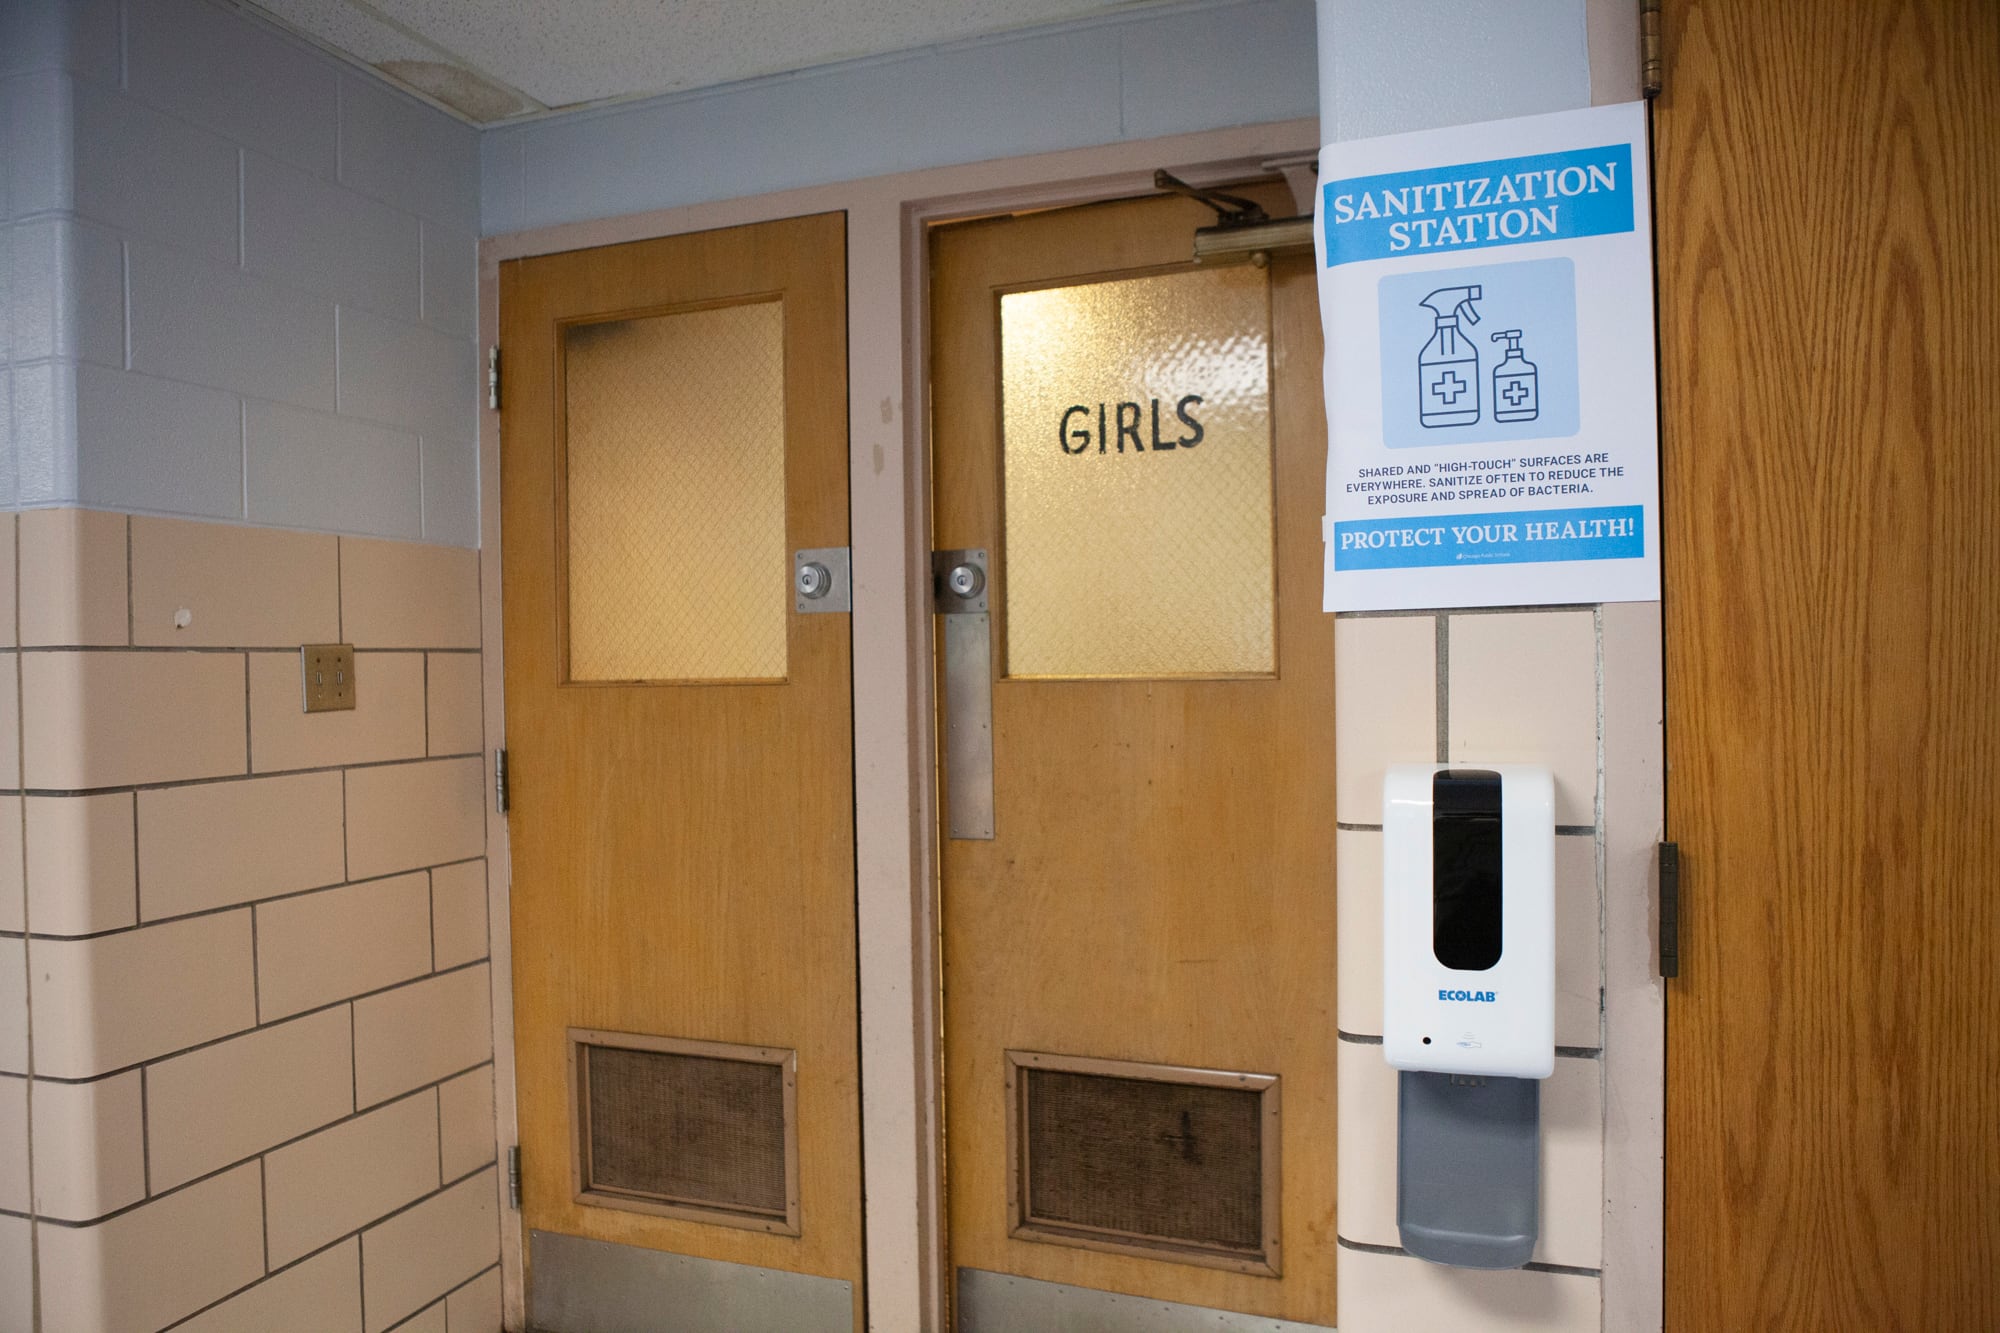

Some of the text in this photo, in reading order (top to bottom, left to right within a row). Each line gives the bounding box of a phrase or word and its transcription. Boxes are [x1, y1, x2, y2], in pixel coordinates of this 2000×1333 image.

[1334, 162, 1617, 224] SANITIZATION
[1389, 205, 1558, 251] STATION
[1059, 395, 1204, 454] GIRLS
[1346, 467, 1624, 493] EVERYWHERE. SANITIZE OFTEN TO REDUCE THE
[1359, 466, 1404, 478] SHARED
[1407, 464, 1431, 474] AND
[1520, 454, 1581, 468] SURFACES
[1585, 453, 1609, 464] ARE
[1368, 483, 1593, 505] EXPOSURE AND SPREAD OF BACTERIA.
[1341, 518, 1634, 550] PROTECT YOUR HEALTH!
[1439, 989, 1495, 1002] ECOLAB
